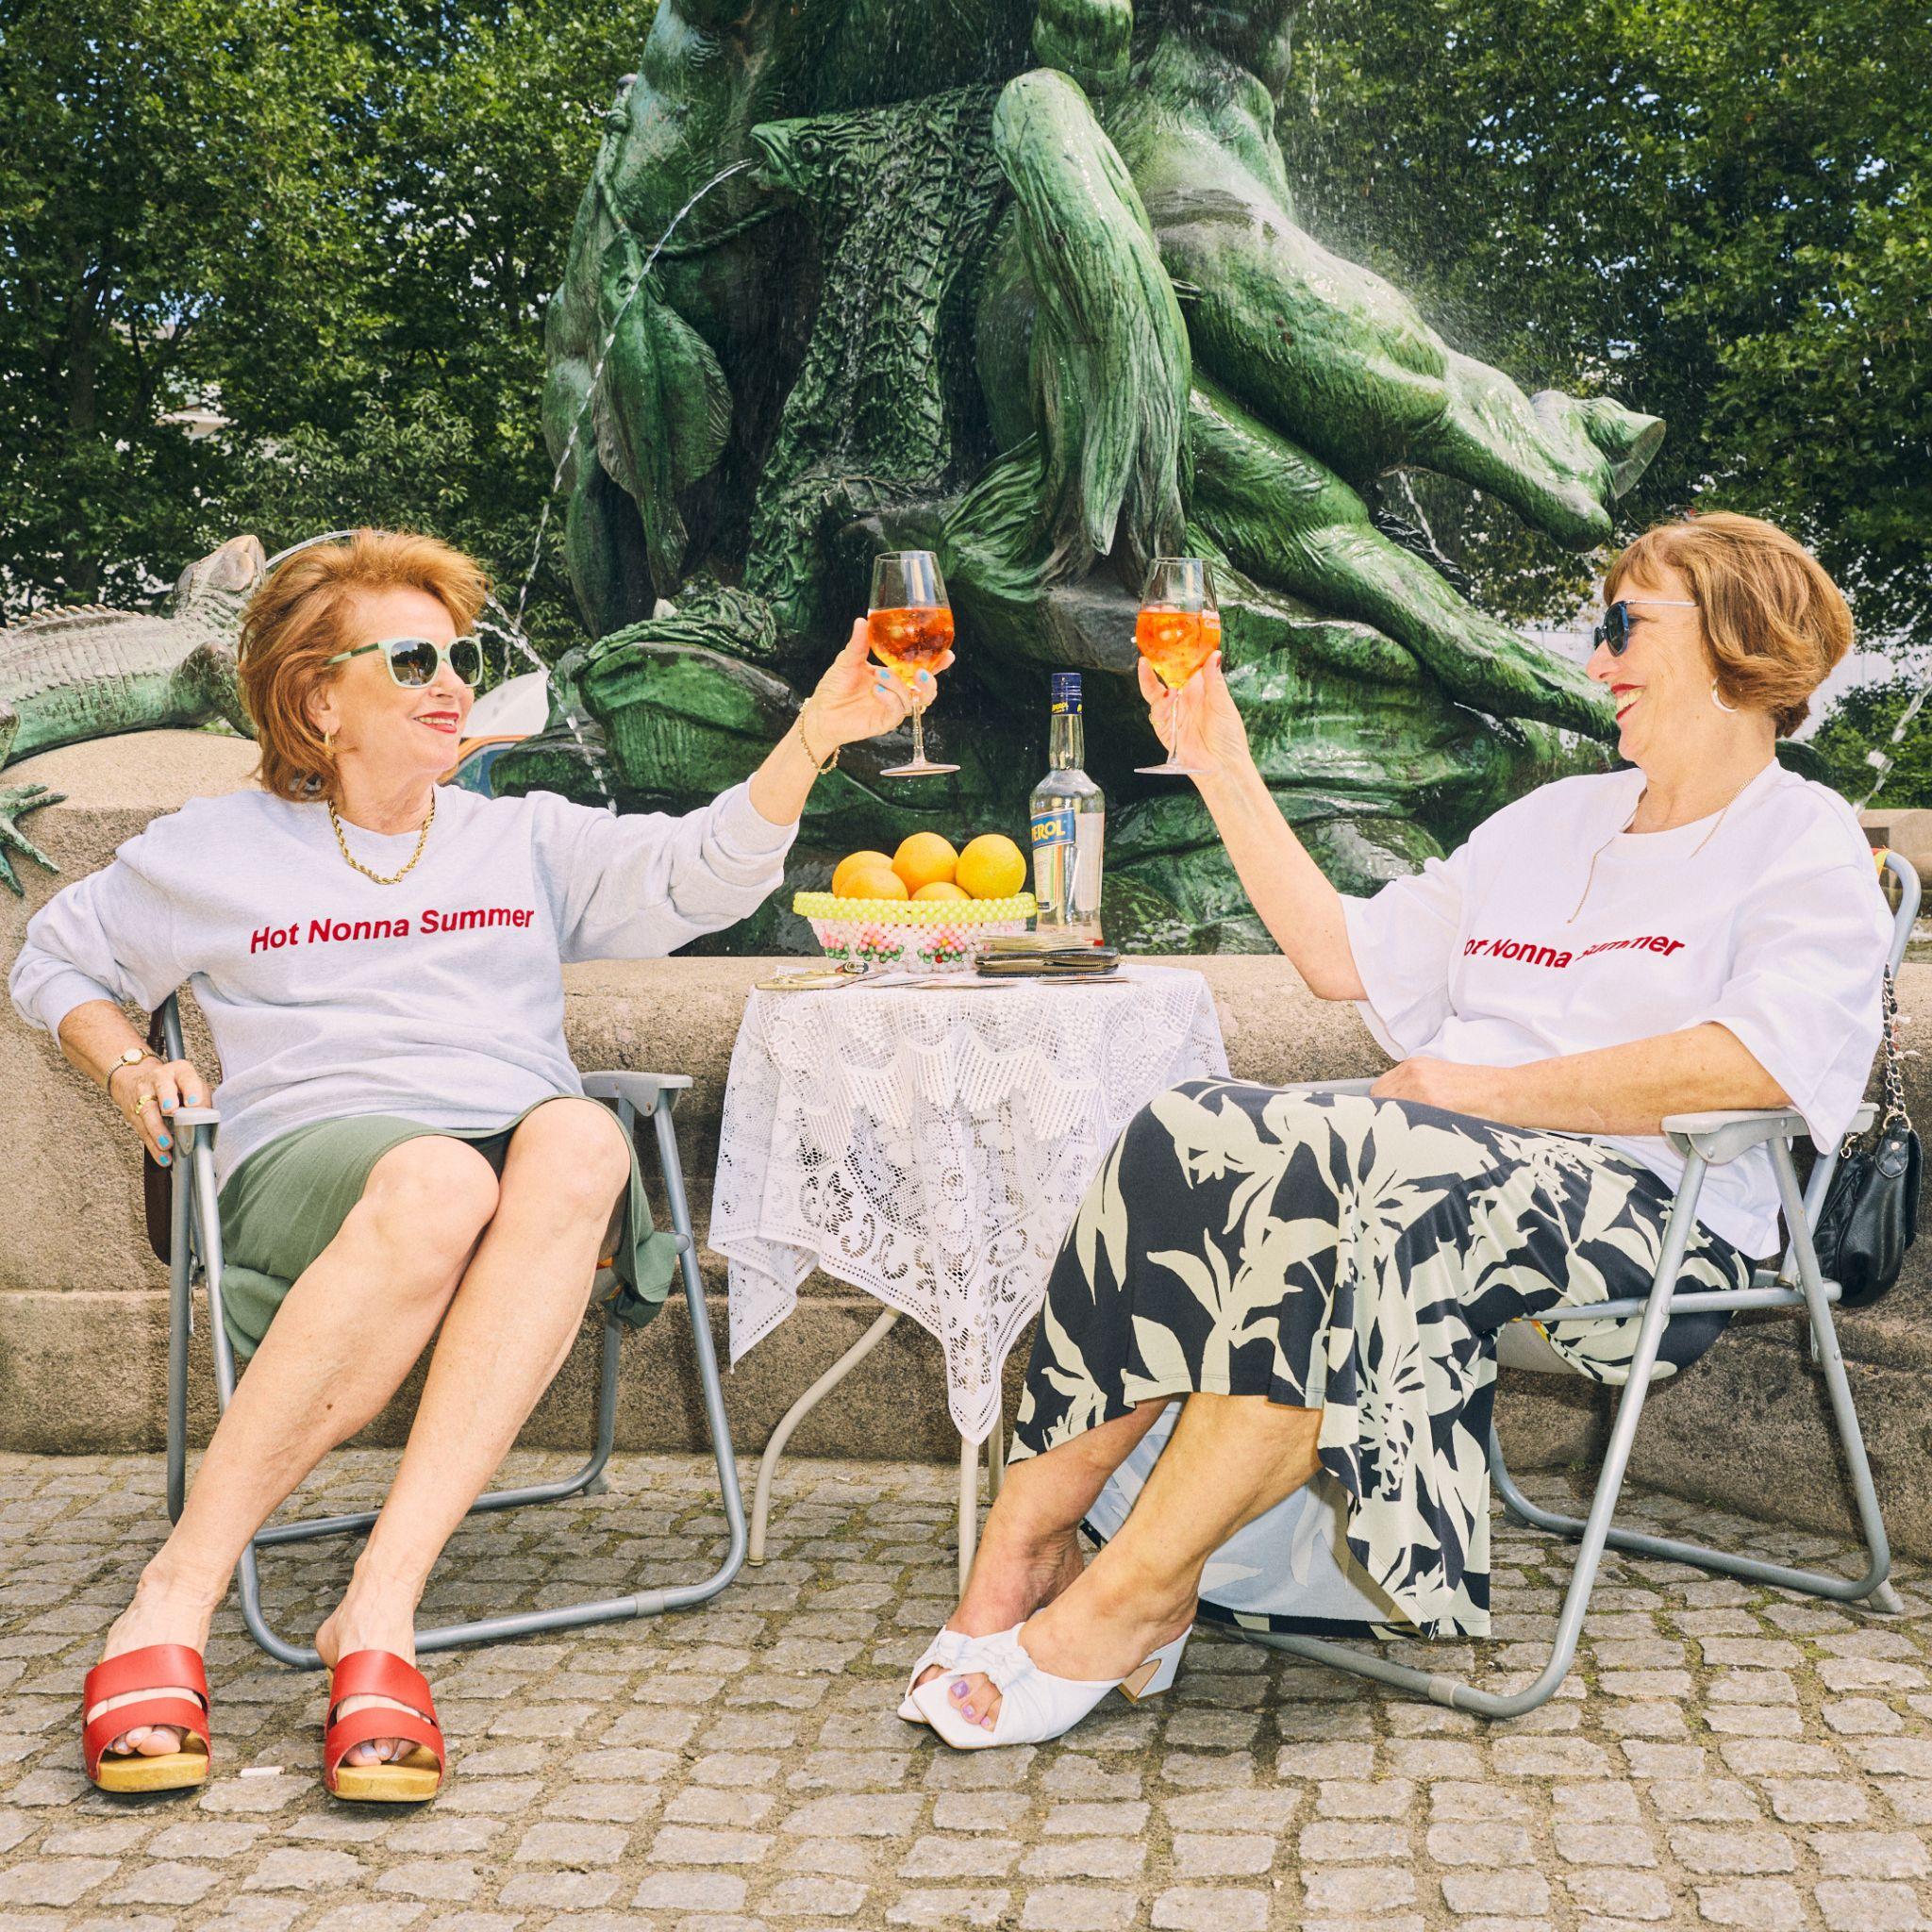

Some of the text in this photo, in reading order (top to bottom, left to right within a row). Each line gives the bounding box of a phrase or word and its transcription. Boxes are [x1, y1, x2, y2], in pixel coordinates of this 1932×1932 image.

[1031, 819, 1066, 841] EROL
[250, 908, 535, 954] Hot Nonna Summer
[1463, 939, 1490, 957] ot
[1483, 939, 1573, 969] Nonna
